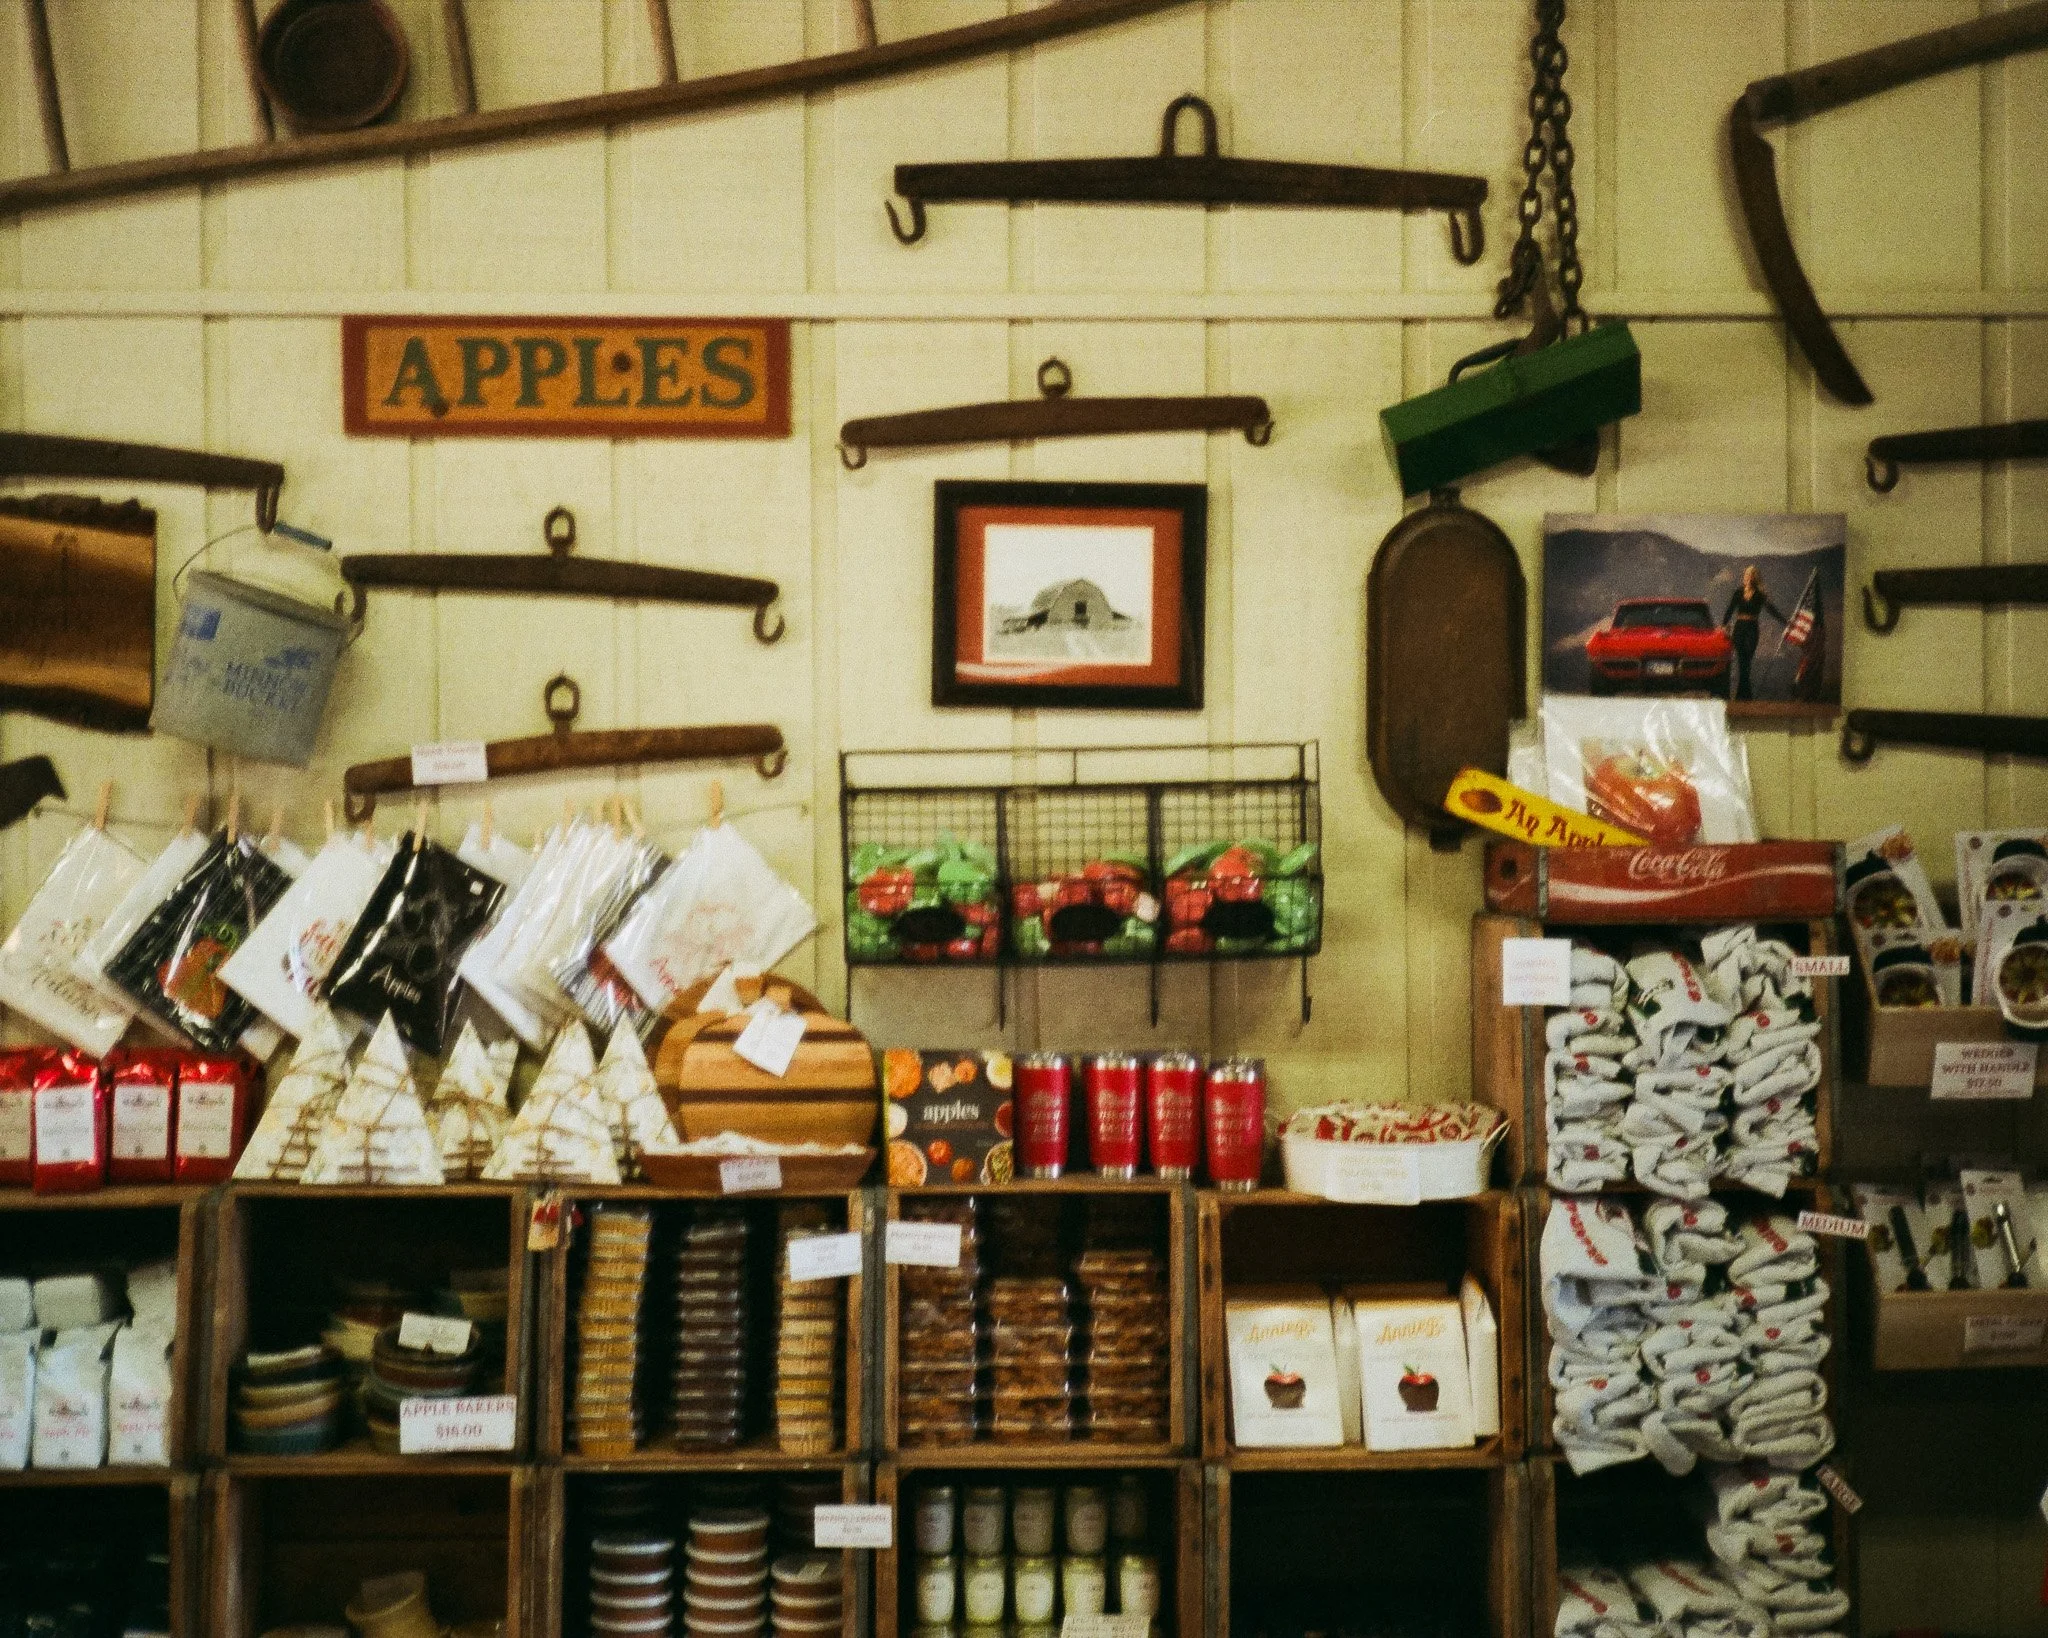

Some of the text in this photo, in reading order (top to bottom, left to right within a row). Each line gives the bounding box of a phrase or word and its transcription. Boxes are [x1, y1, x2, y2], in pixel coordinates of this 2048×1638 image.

[381, 336, 757, 418] APPLES
[1627, 847, 1729, 882] Coca-Cola
[1795, 960, 1844, 975] SMALL
[1942, 1061, 2031, 1075] WITH HANDLE
[923, 1101, 980, 1124] apples
[1802, 1214, 1865, 1236] MEDIUM
[403, 1400, 515, 1417] APPLE BAKERS
